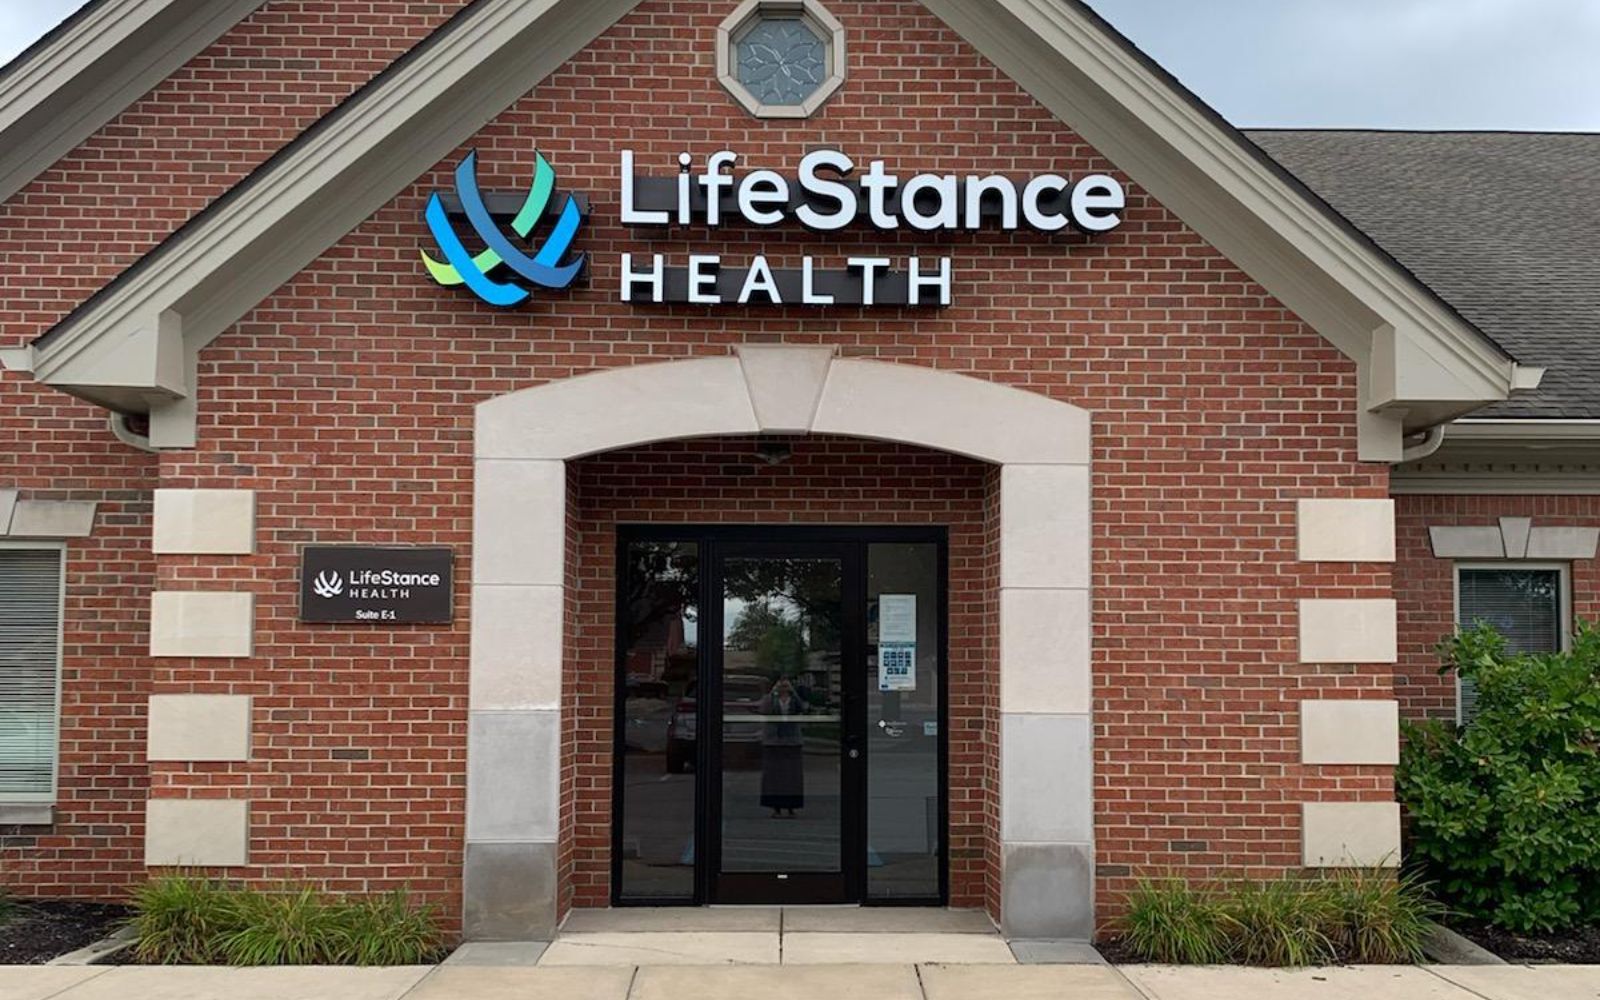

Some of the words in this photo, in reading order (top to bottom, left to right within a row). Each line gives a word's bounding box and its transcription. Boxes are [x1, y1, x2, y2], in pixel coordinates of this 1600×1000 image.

[621, 149, 1125, 231] LifeStance
[621, 253, 952, 307] HEALTH
[349, 570, 441, 586] LifeStance
[349, 588, 410, 599] HEALTH
[355, 609, 380, 620] Suite
[381, 610, 396, 620] E-1
